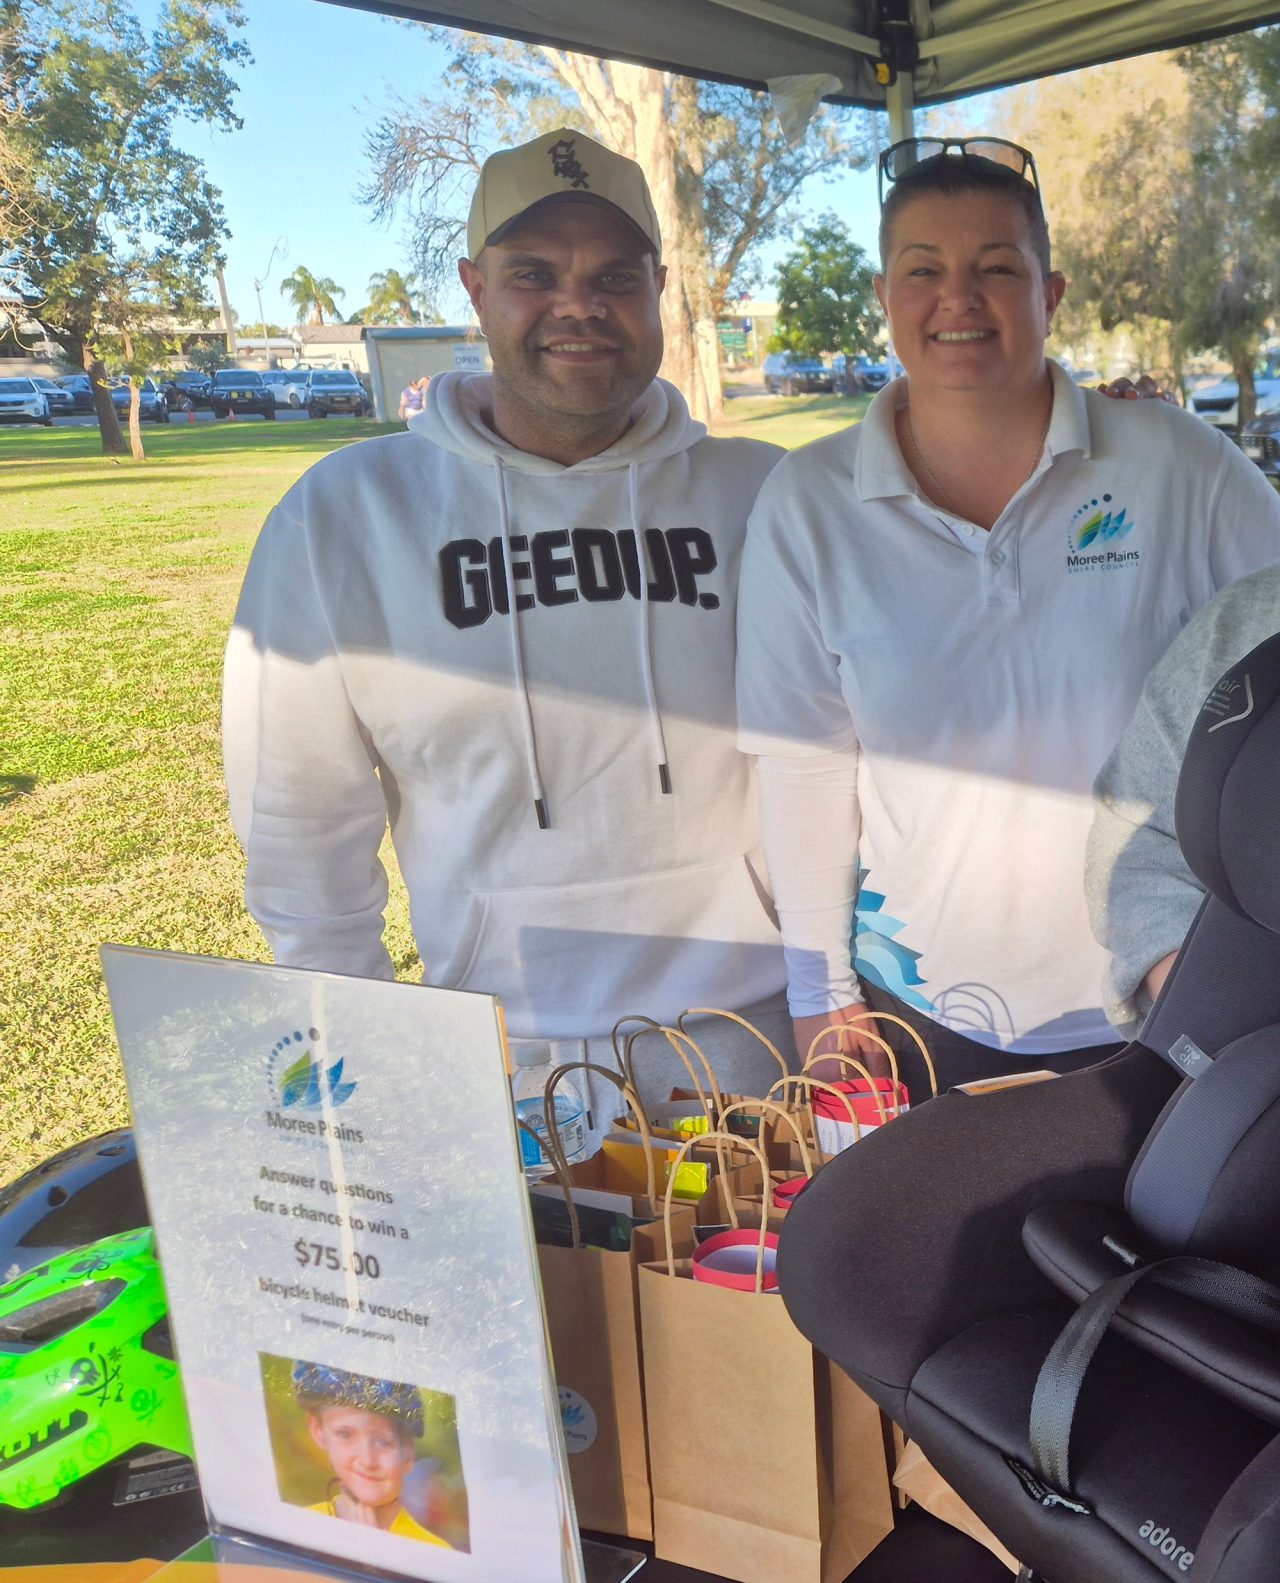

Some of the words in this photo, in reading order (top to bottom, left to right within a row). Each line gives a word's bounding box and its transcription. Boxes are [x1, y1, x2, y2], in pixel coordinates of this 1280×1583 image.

[1067, 555, 1105, 567] Moree
[1107, 550, 1140, 563] Plains
[266, 1111, 315, 1135] Moree
[259, 1166, 315, 1189] Answer
[253, 1195, 275, 1213] for
[279, 1204, 288, 1215] a
[291, 1204, 342, 1227] chance
[349, 1215, 364, 1231] to
[367, 1219, 396, 1238] win
[400, 1226, 410, 1240] a
[294, 1237, 380, 1279] $75.00
[258, 1276, 310, 1300] bicycle
[368, 1302, 430, 1327] voucher
[1138, 1519, 1194, 1571] adore
